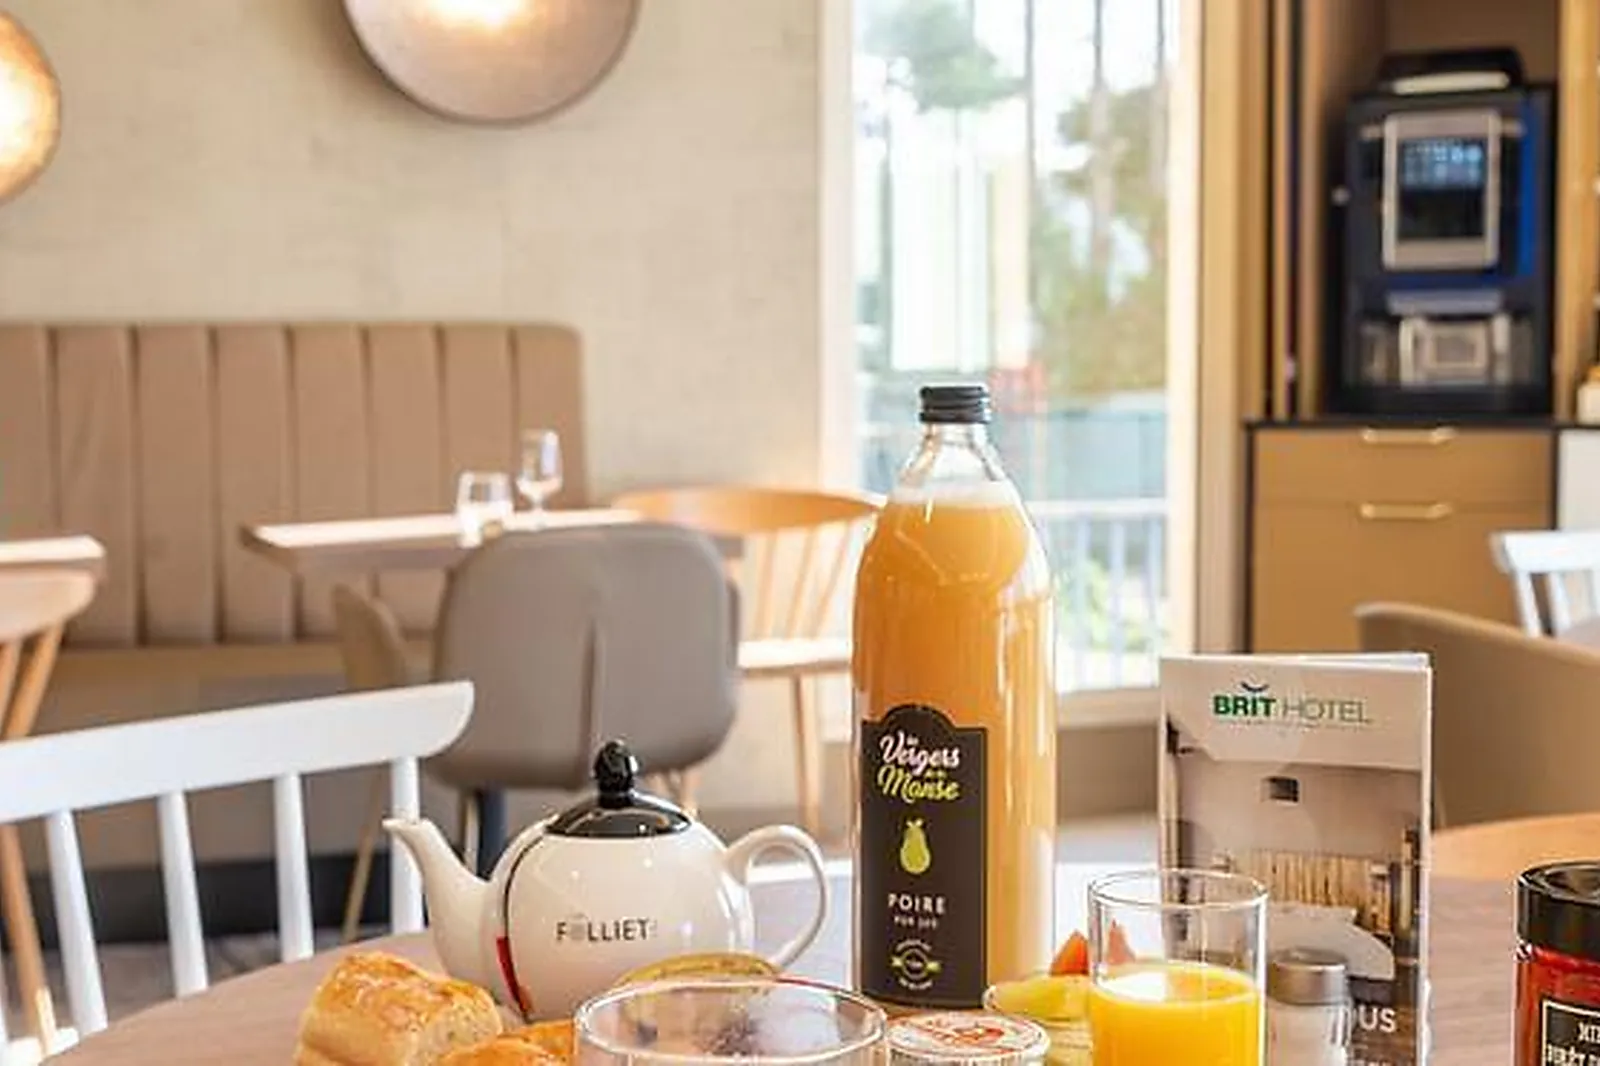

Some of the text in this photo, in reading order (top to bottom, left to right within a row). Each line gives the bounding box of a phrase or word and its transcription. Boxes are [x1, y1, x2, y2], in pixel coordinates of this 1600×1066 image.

[1213, 694, 1375, 726] BRIT HOTEL
[887, 892, 946, 915] POIRE
[1351, 1004, 1396, 1033] US
